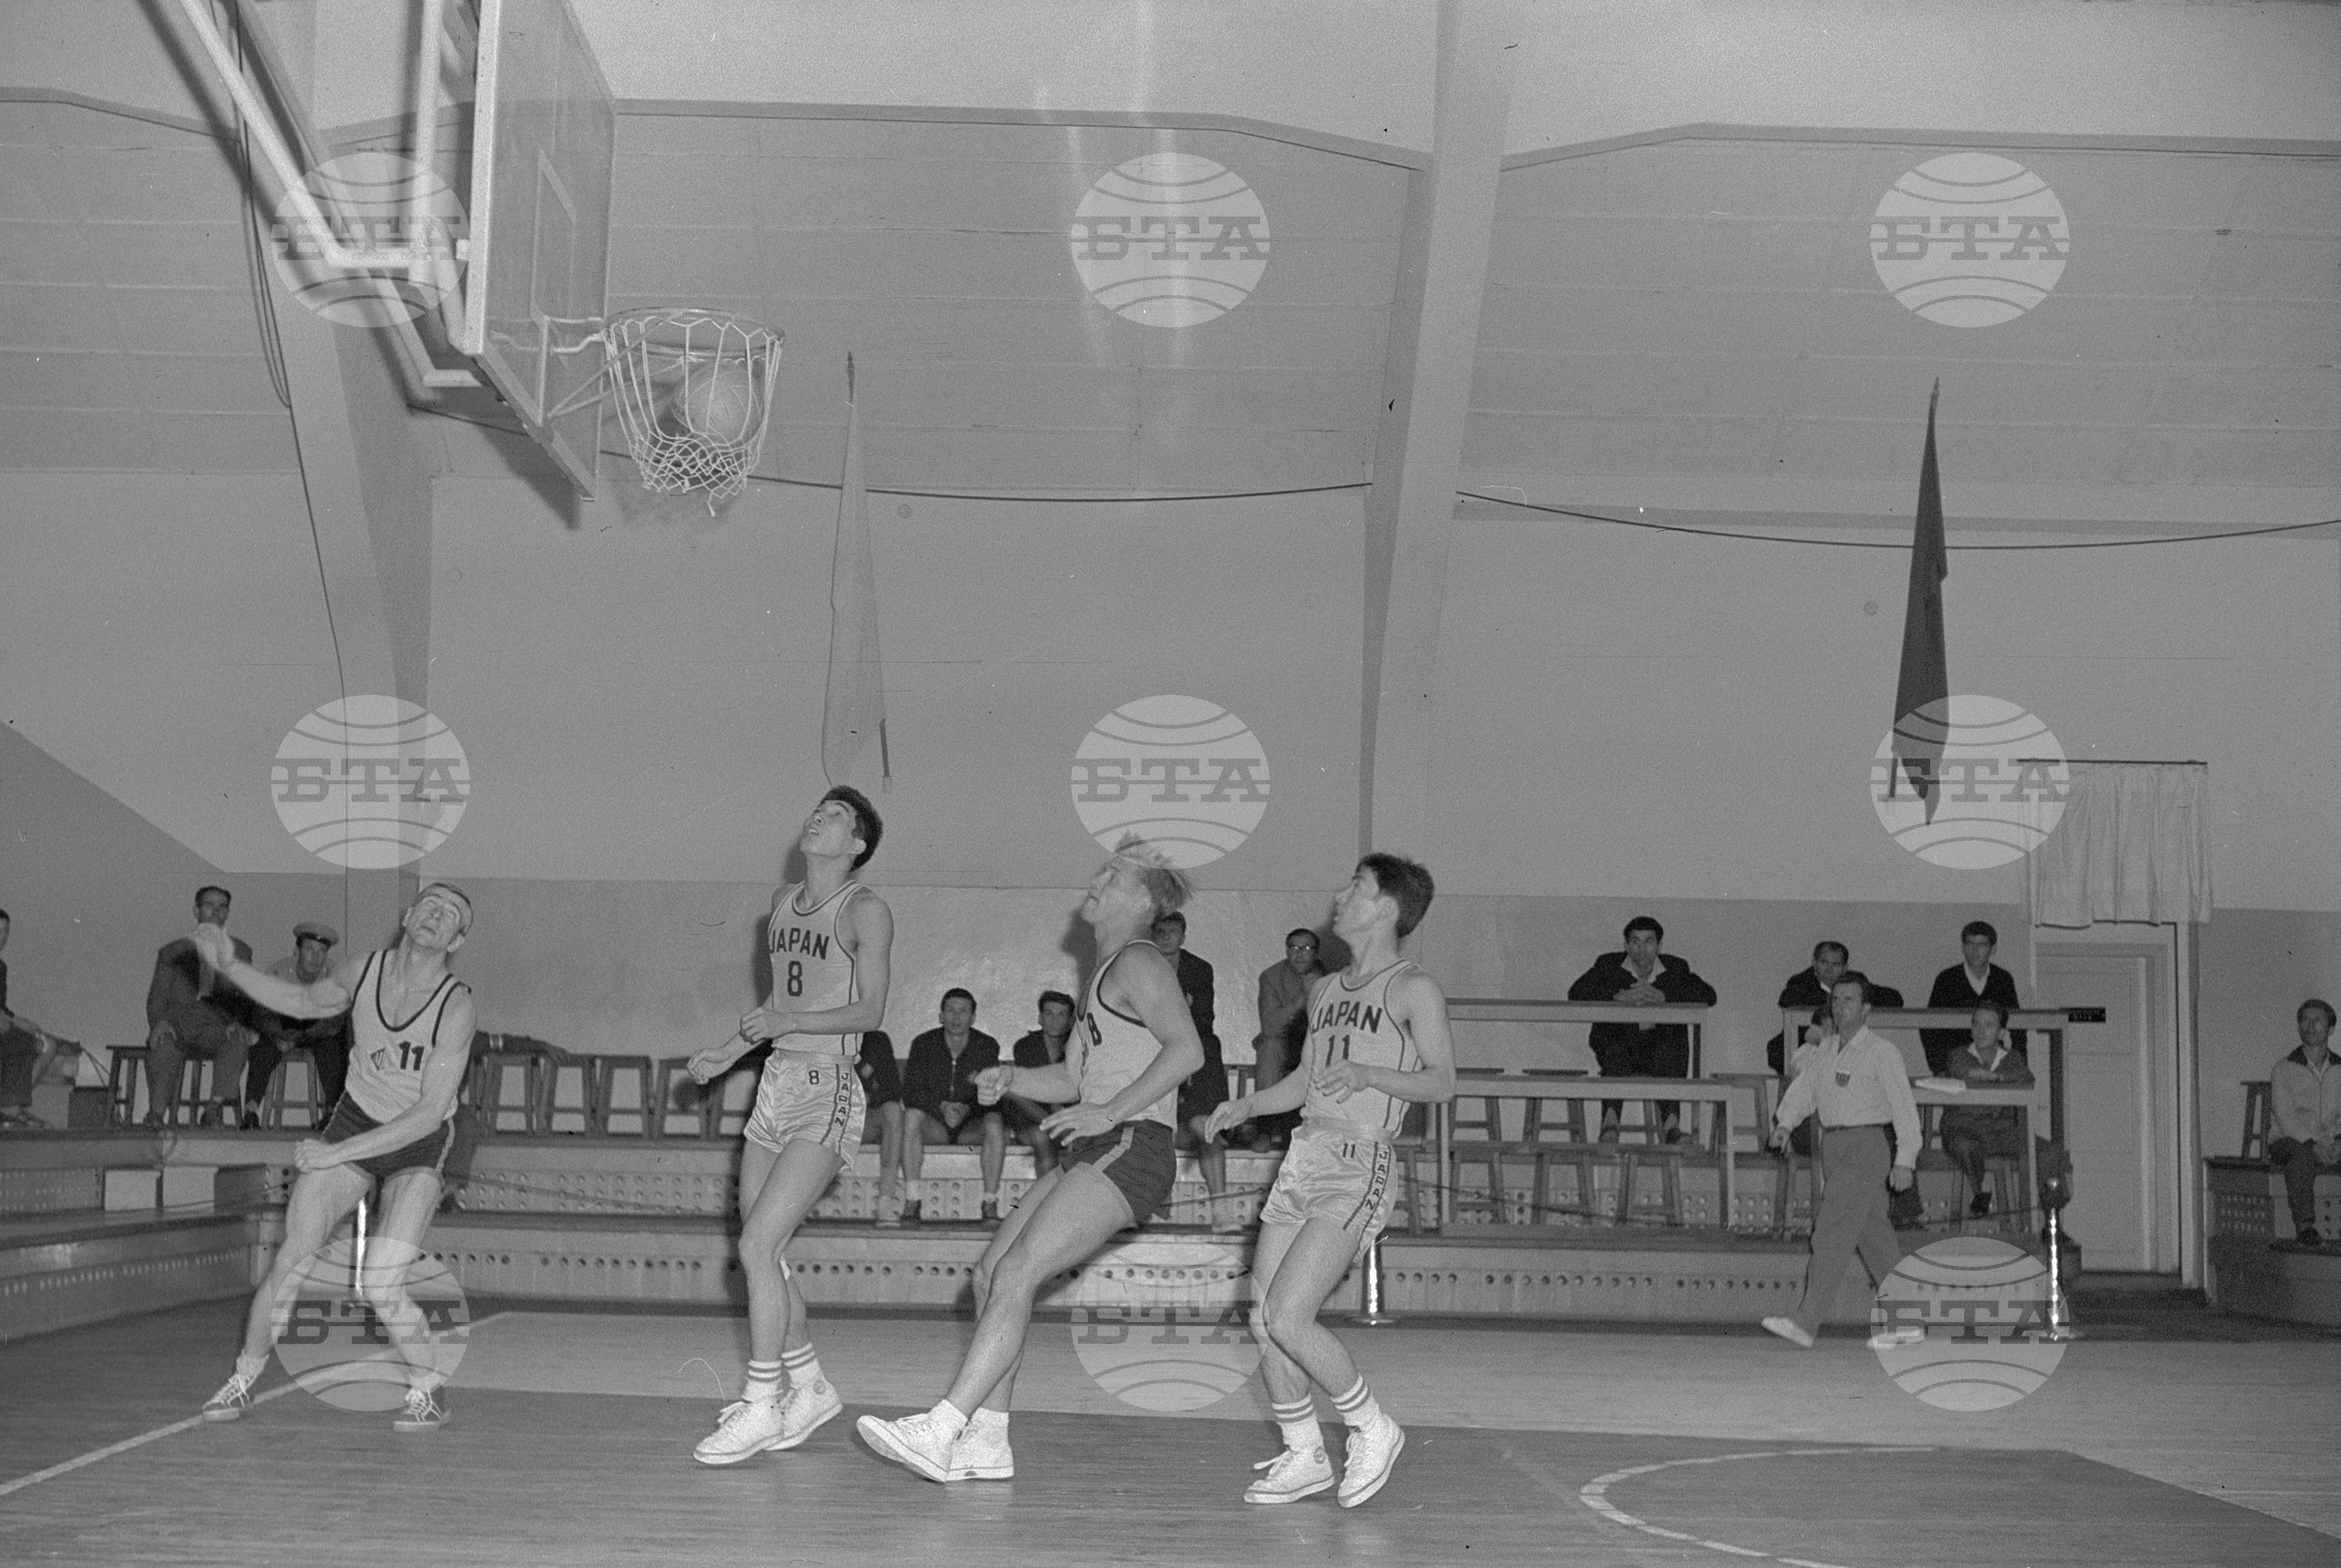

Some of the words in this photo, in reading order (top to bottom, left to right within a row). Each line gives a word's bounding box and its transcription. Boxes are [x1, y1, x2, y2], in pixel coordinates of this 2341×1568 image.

[770, 927, 829, 960] JAPAN
[787, 960, 802, 997] 8
[1311, 1001, 1382, 1034] JAPAN
[399, 1041, 424, 1071] 11
[1326, 1035, 1350, 1068] 11
[809, 1070, 819, 1085] 8
[835, 1072, 849, 1127] JAPAN
[1343, 1142, 1355, 1158] 11
[1365, 1151, 1388, 1210] JAPAN
